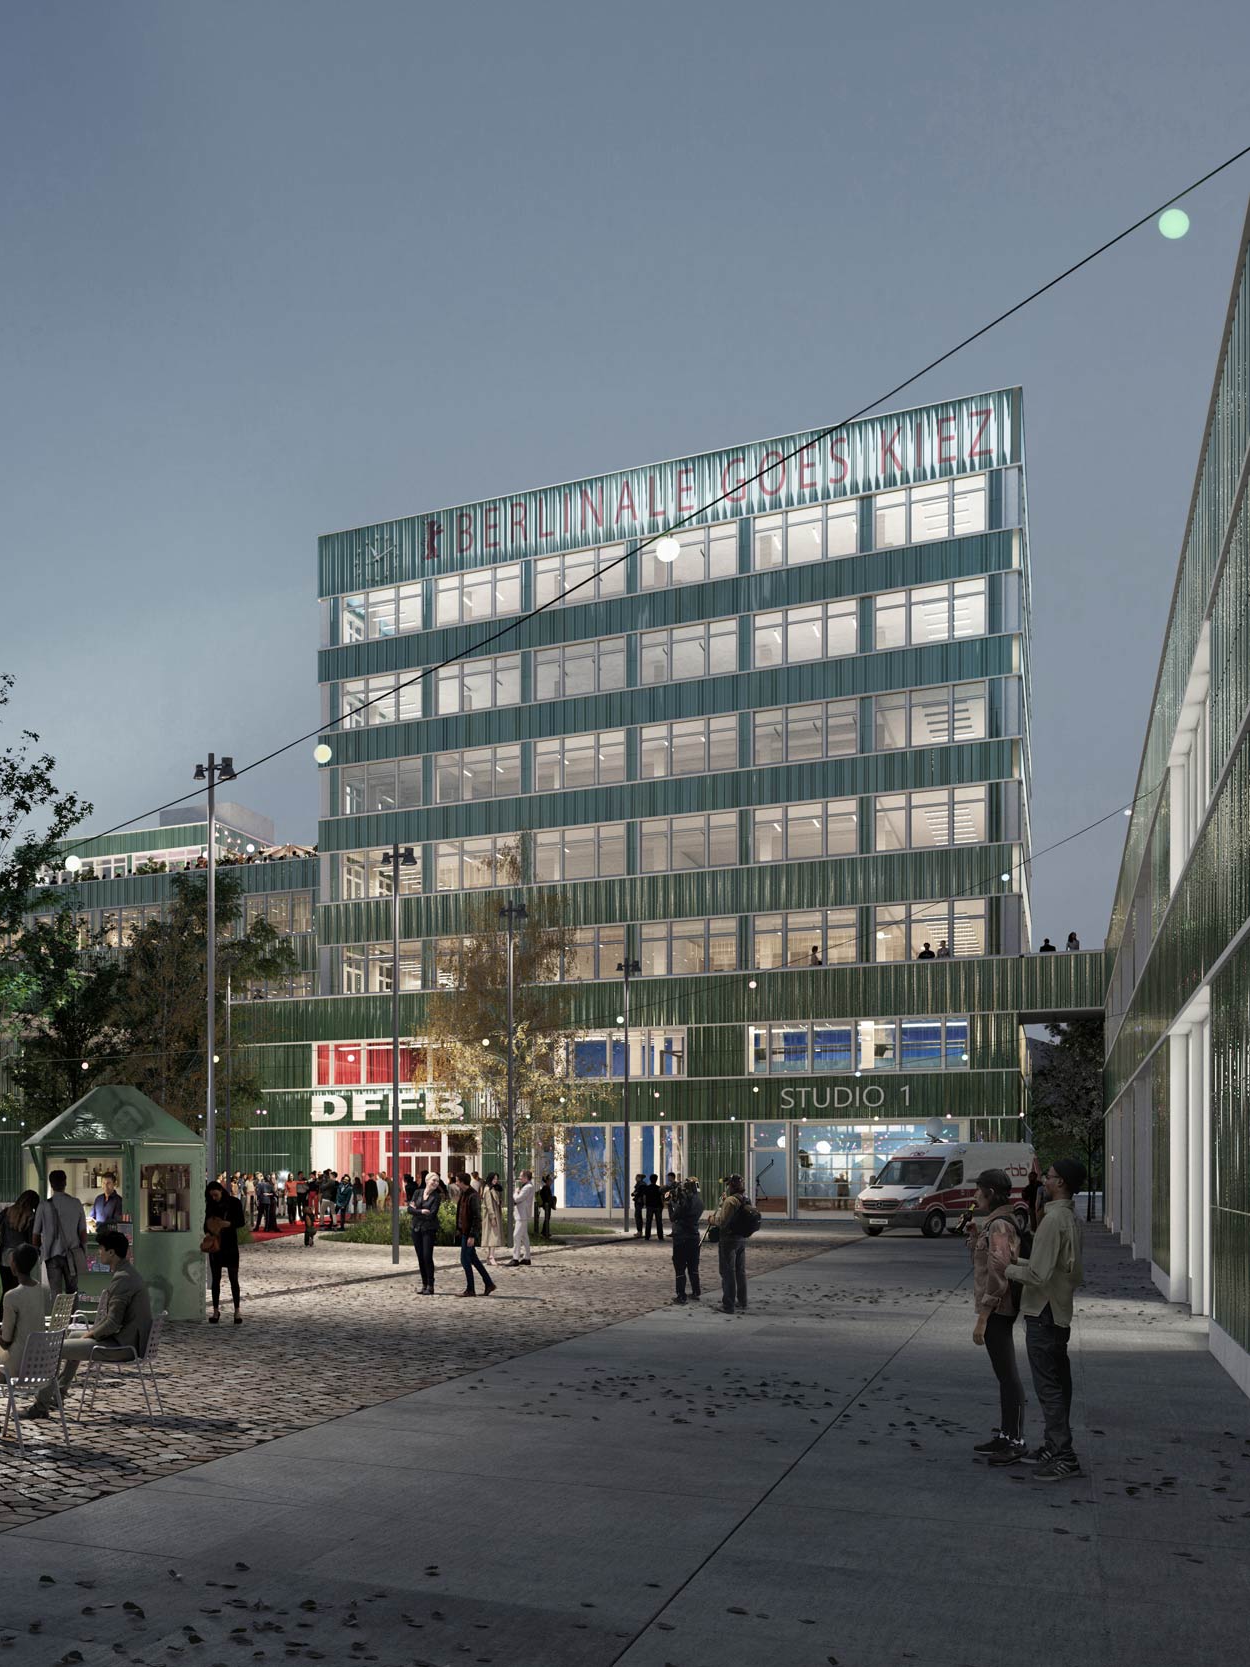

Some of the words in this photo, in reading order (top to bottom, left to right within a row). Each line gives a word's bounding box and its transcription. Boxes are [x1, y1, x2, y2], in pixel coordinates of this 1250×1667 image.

[456, 467, 695, 555] BERLINALE
[721, 437, 849, 503] GOES
[880, 408, 994, 475] KIEZ
[311, 1091, 465, 1122] DFFB
[780, 1085, 885, 1109] STUDIO
[900, 1084, 910, 1107] 1
[1004, 1163, 1028, 1177] rbb
